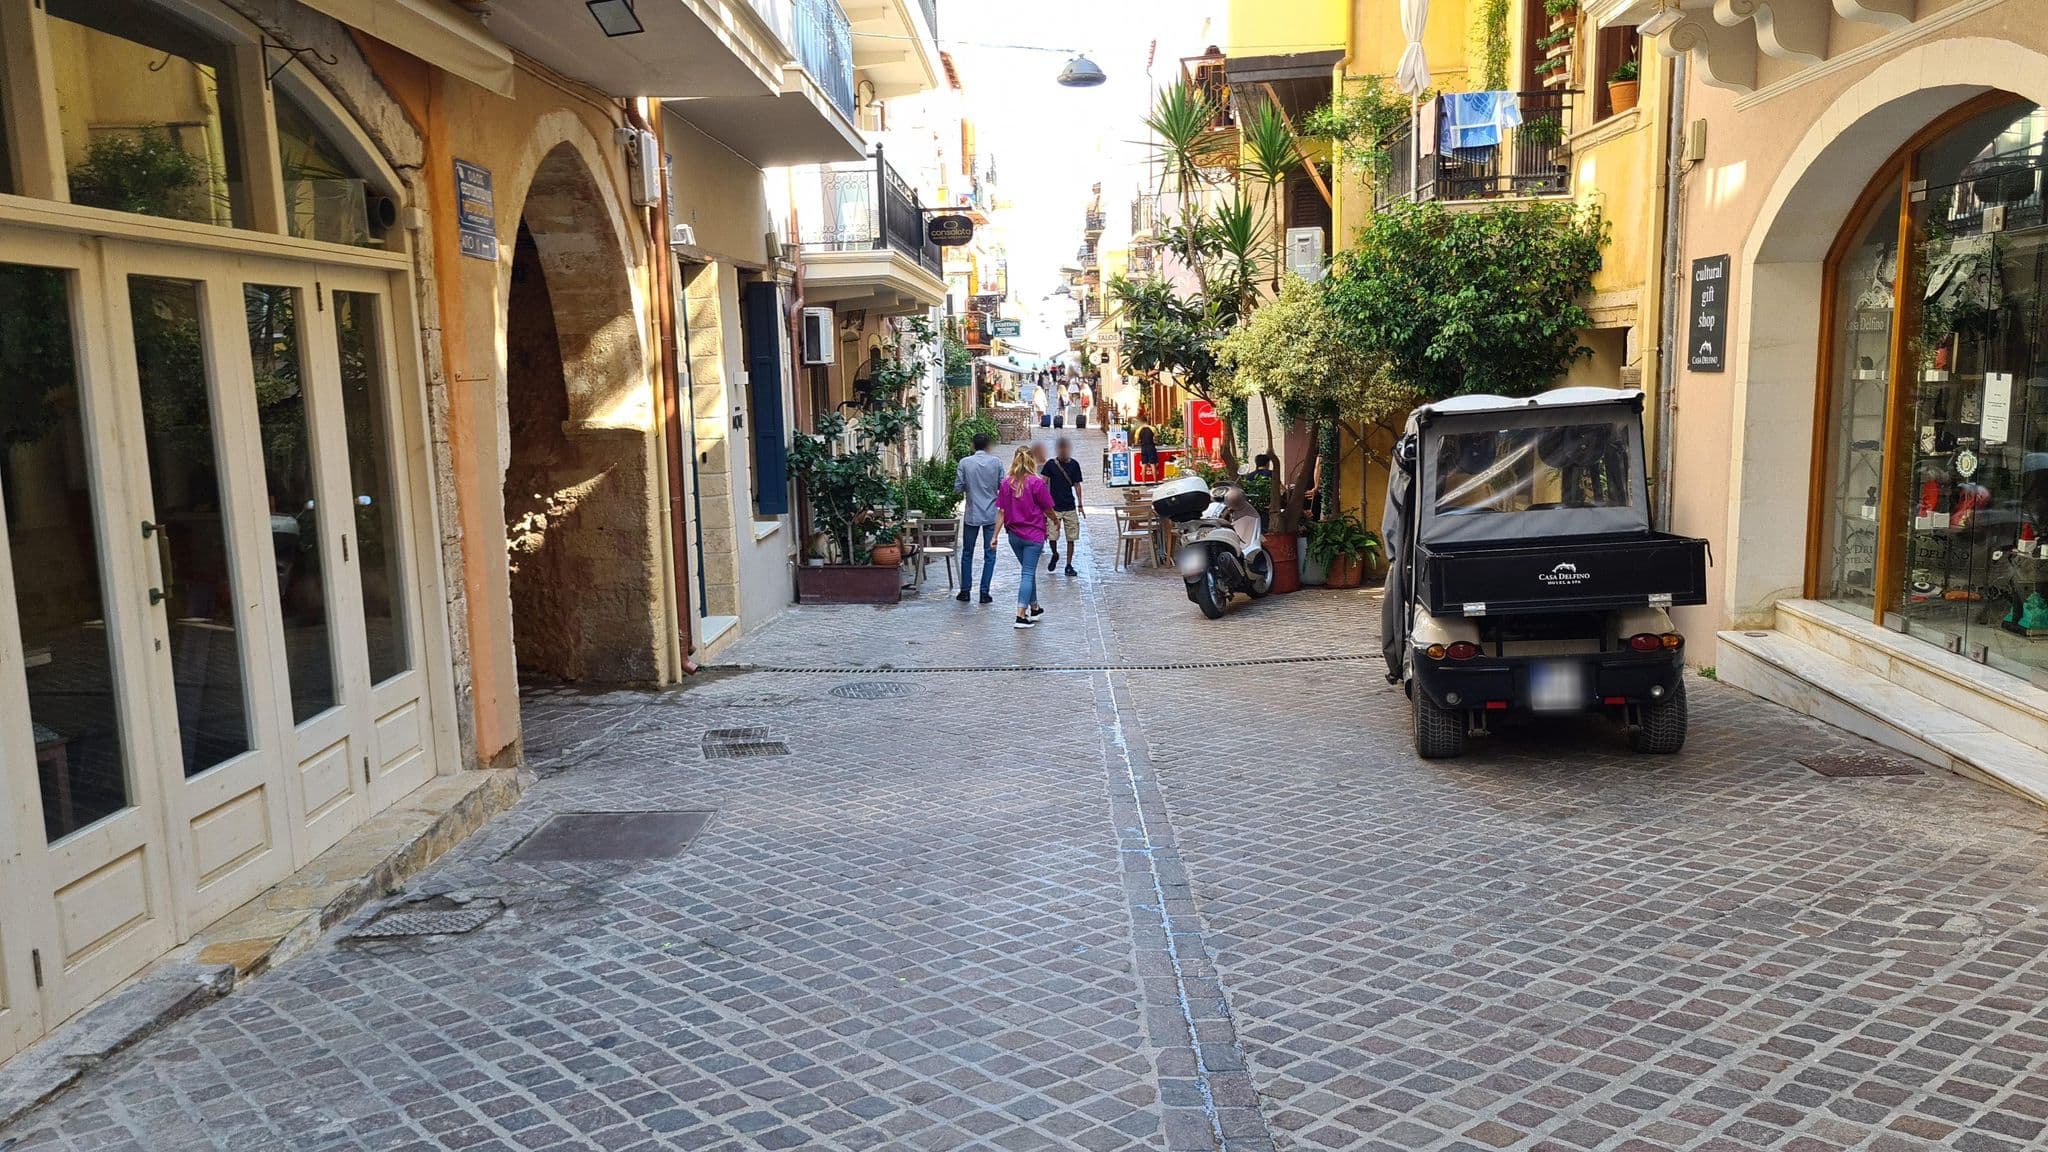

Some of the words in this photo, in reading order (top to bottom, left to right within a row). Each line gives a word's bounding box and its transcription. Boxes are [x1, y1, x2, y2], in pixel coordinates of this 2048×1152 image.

[1695, 262, 1722, 282] cultural
[1701, 286, 1715, 307] gift
[1698, 311, 1715, 331] shop
[1538, 573, 1558, 581] CASA
[1558, 572, 1591, 580] DELFINO
